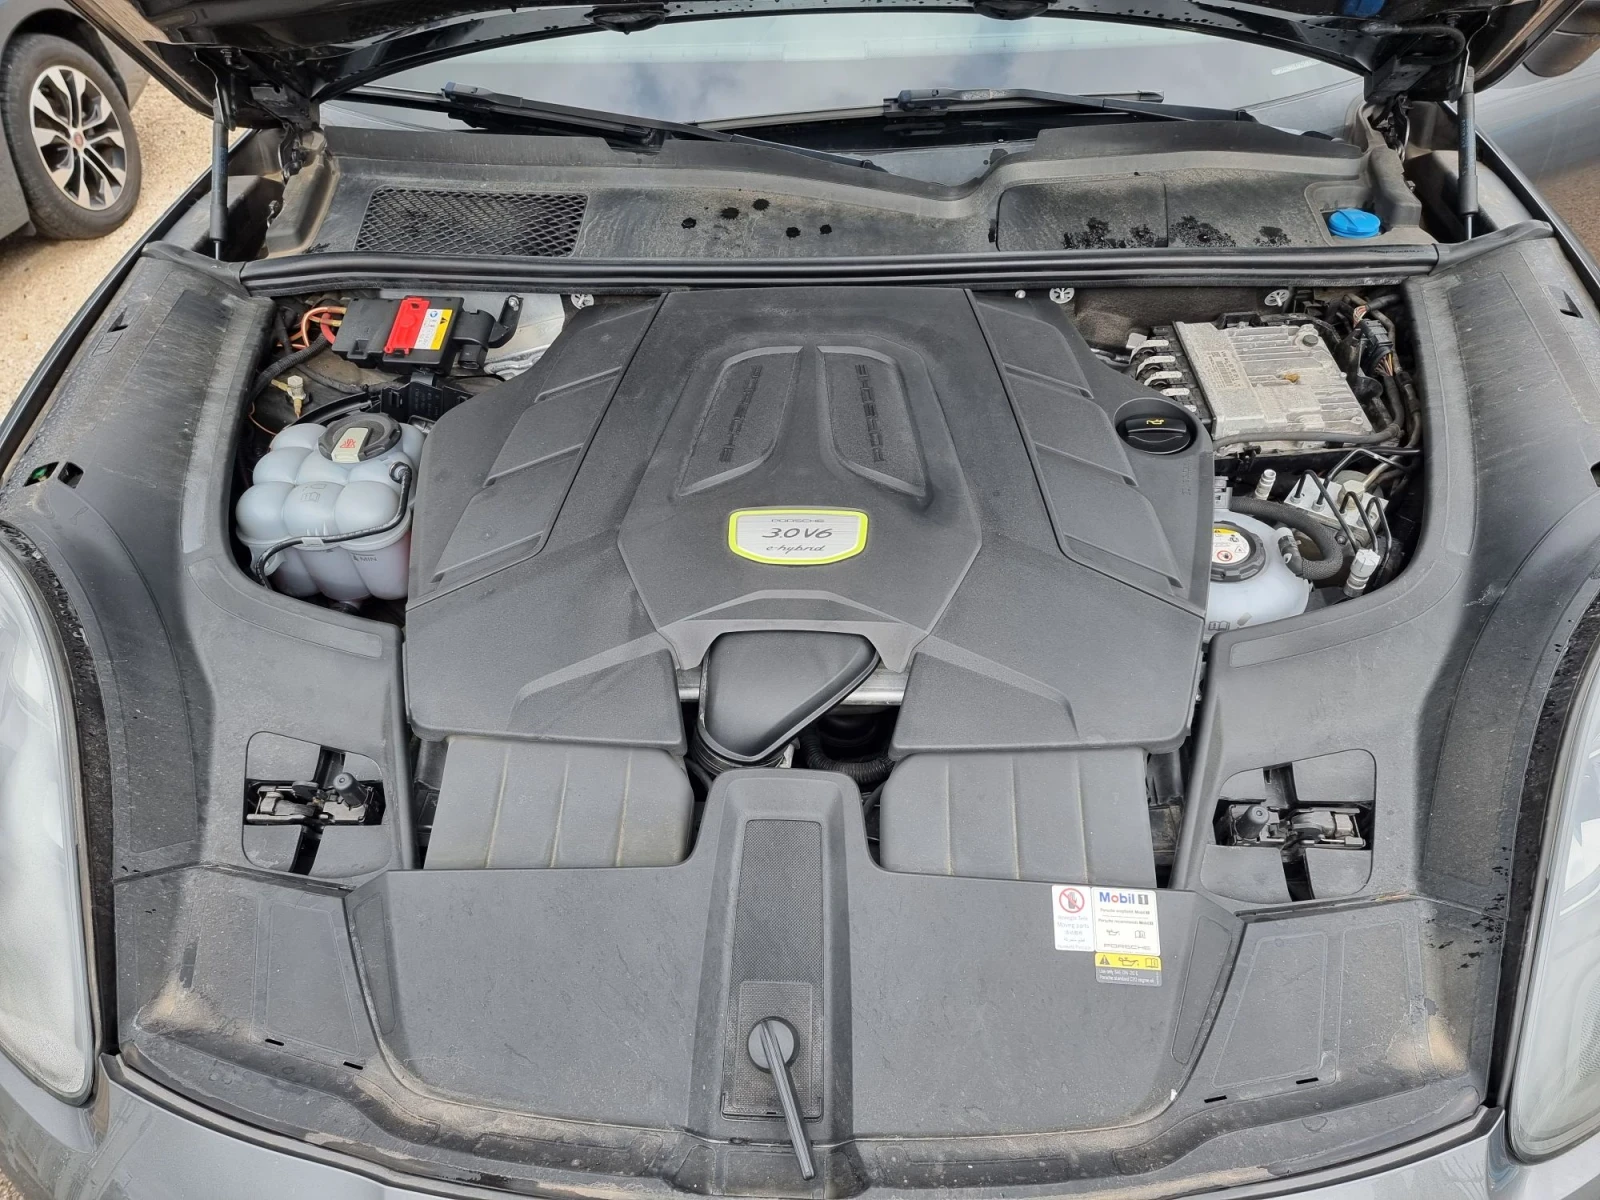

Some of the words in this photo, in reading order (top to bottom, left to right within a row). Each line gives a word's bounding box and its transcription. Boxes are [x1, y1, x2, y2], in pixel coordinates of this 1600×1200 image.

[855, 364, 885, 462] PORSCHE
[762, 527, 801, 539] 3.0
[803, 527, 833, 539] V6
[765, 544, 826, 555] e-hybrid
[1099, 892, 1135, 904] Mobil
[1138, 894, 1149, 905] 1
[1103, 943, 1152, 951] PORSCHE
